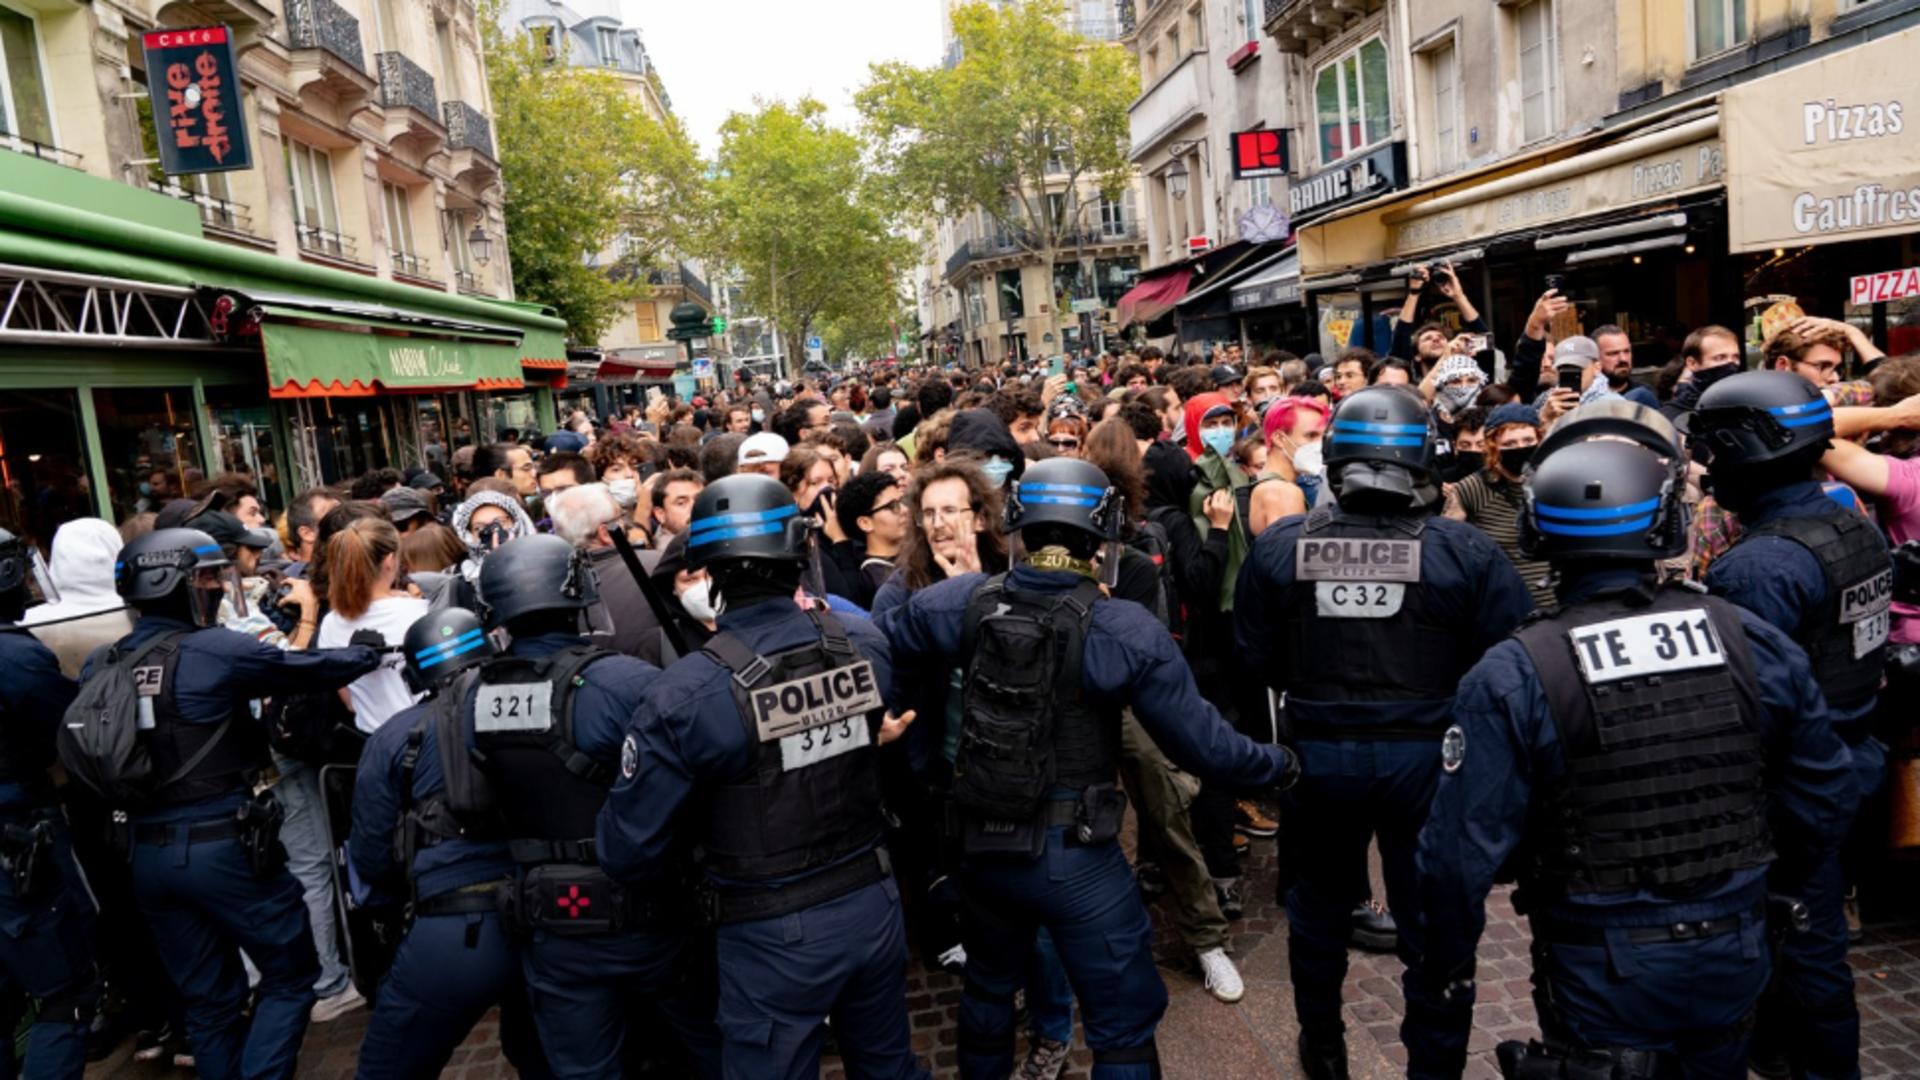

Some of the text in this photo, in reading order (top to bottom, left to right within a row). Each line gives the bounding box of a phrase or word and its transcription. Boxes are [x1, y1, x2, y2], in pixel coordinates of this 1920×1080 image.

[159, 31, 211, 46] Café
[1803, 99, 1904, 144] Pizzas
[1633, 160, 1682, 197] Pizzas
[1853, 268, 1920, 304] PIZZA
[1303, 542, 1410, 564] POLICE
[1332, 585, 1387, 606] C32
[1845, 571, 1892, 612] POLICE
[1578, 618, 1717, 671] TE 311
[491, 694, 533, 718] 321
[756, 665, 874, 722] POLICE
[801, 718, 851, 751] 323
